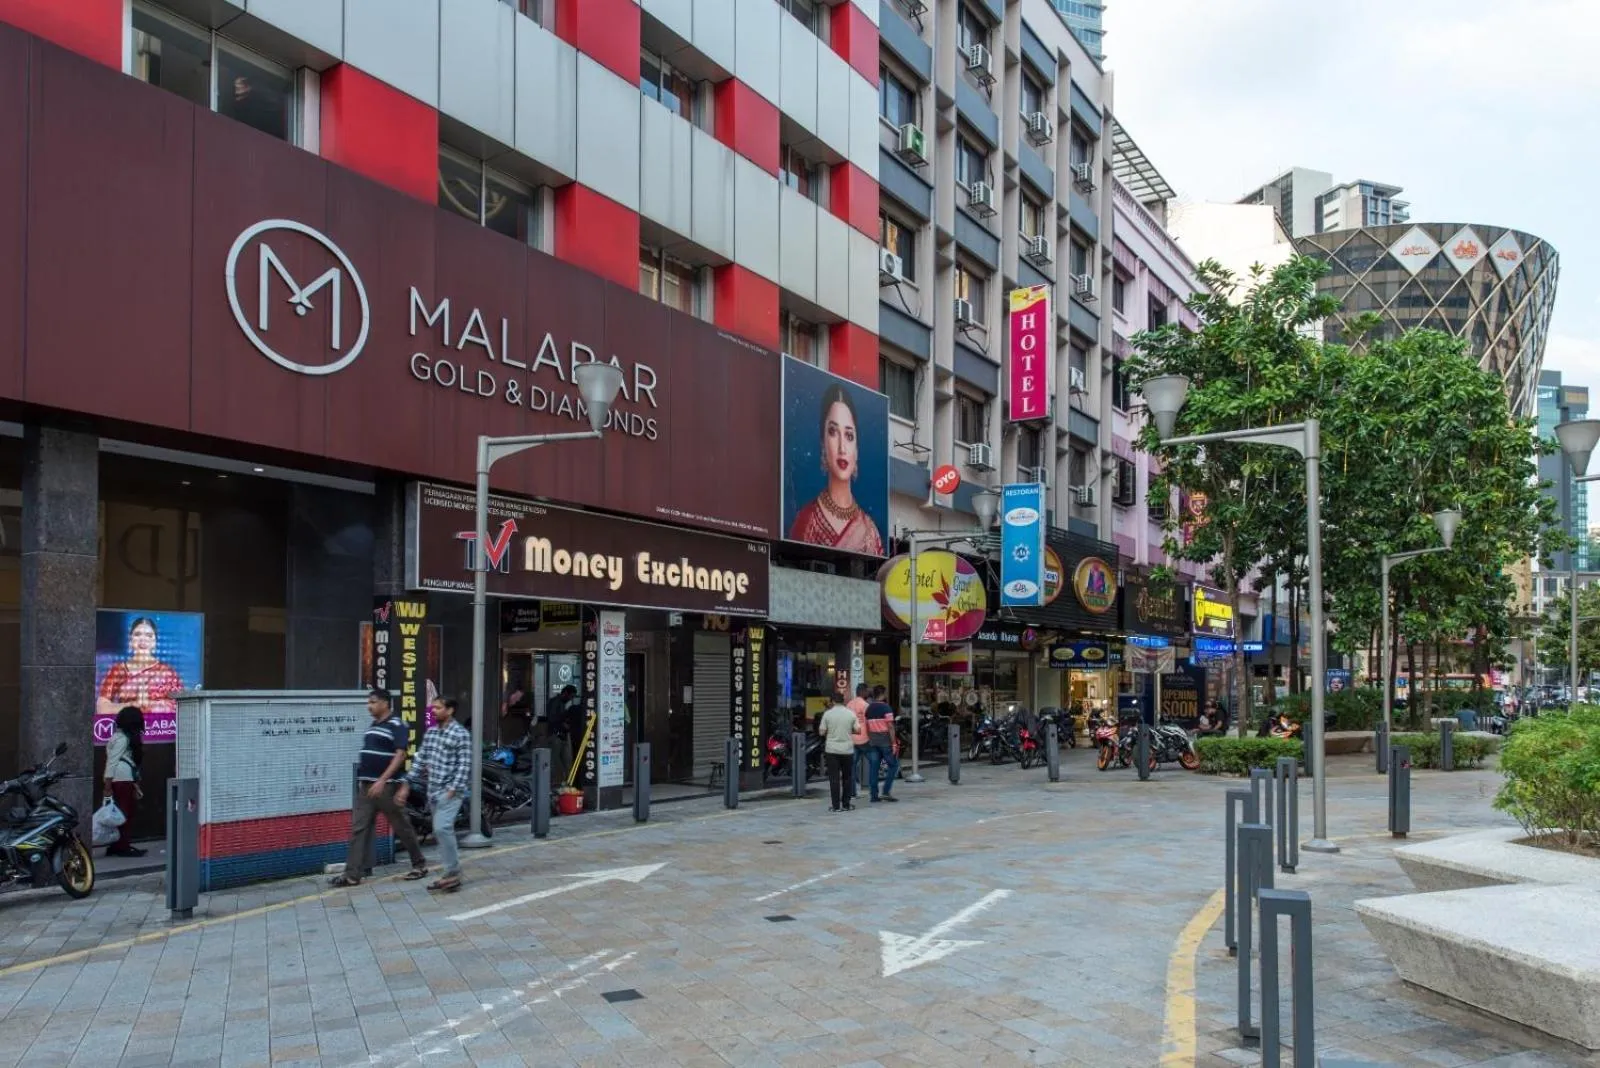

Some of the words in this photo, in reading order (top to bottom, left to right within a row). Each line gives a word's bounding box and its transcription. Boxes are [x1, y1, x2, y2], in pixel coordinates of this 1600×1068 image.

[410, 351, 497, 398] GOLD
[504, 379, 523, 406] &
[1020, 312, 1036, 413] HOTEL
[935, 470, 956, 488] OYO
[1005, 488, 1039, 496] RESTORAN
[524, 535, 623, 591] Money
[637, 551, 749, 602] Exchange
[399, 622, 420, 722] WESTERN
[751, 642, 762, 712] WESTERN
[144, 720, 177, 730] LABA
[1162, 700, 1198, 718] SOON
[751, 716, 760, 768] UNION
